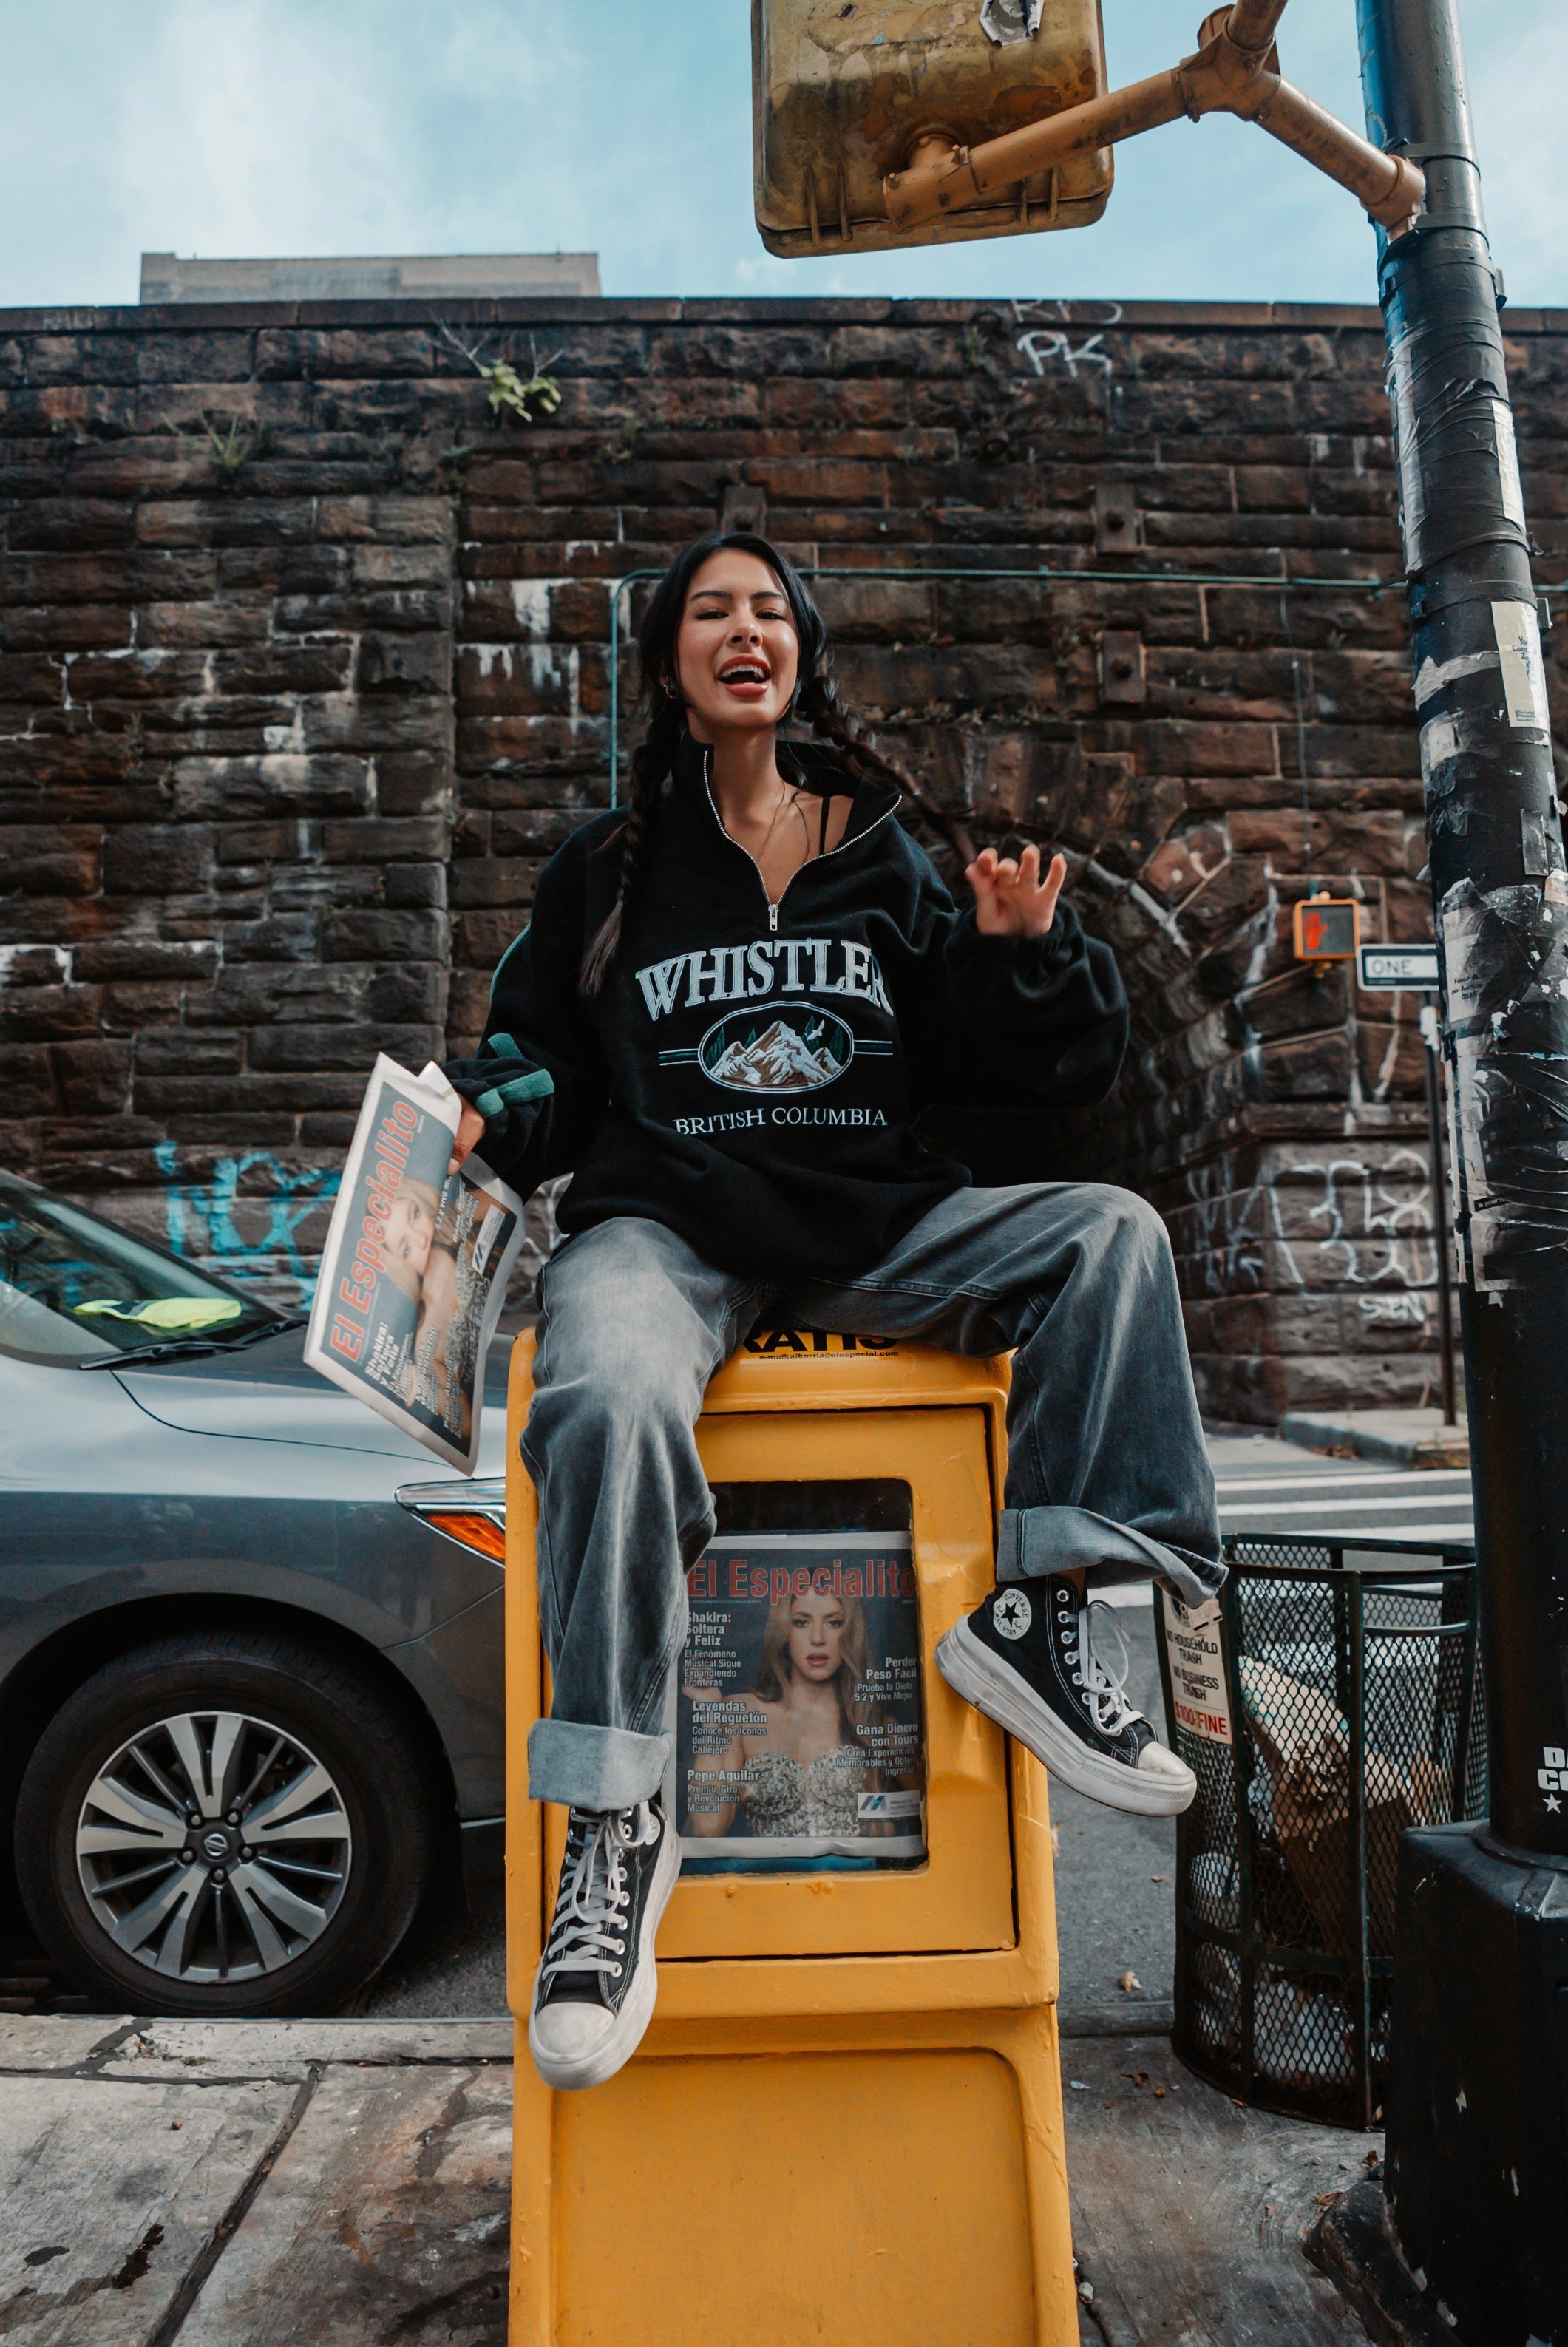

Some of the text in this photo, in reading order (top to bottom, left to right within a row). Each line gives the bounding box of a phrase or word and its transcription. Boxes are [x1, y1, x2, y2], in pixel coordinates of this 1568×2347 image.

[1371, 959, 1413, 975] ONE
[635, 938, 893, 1022] WHISTLER
[673, 1107, 889, 1135] BRITISH COLUMBIA
[330, 1101, 419, 1363] El Especialito
[688, 1559, 916, 1606] El Especialito
[1005, 1593, 1028, 1618] CONVERSE
[1002, 1626, 1017, 1635] STAR
[685, 1634, 721, 1648] y Feliz
[1167, 1629, 1218, 1654] NO HOUSEHOLD
[685, 1648, 736, 1658] El Fenómeno
[1178, 1648, 1203, 1665] TRASH
[684, 1659, 741, 1670] Musical Sigue
[886, 1657, 917, 1668] Perder
[684, 1668, 737, 1679] Expandiendo
[866, 1668, 892, 1680] Peso
[1172, 1665, 1219, 1690] NO BUSINESS
[684, 1677, 724, 1686] Fronteras
[857, 1682, 913, 1692] Prueba la Dieta
[855, 1691, 913, 1702] 5:2 y Vive Mejor
[1183, 1682, 1206, 1701] TRASH
[692, 1700, 746, 1712] Leyendas
[692, 1711, 767, 1725] del Reguetón
[1175, 1700, 1228, 1735] $100 FINE
[692, 1726, 722, 1735] Conoce
[725, 1726, 737, 1735] los
[856, 1722, 918, 1736] Gana Dinero
[692, 1736, 731, 1745] del Ritmo
[871, 1735, 919, 1747] con Tours
[692, 1745, 728, 1755] Callejero
[846, 1747, 914, 1759] Crea Experiencias
[836, 1758, 886, 1767] Memorables
[889, 1759, 893, 1767] y
[1543, 1746, 1568, 1768] D
[687, 1770, 760, 1783] Pepe Aguilar
[885, 1767, 915, 1776] Ingresos
[687, 1784, 738, 1794] Premio, Gira
[687, 1796, 693, 1804] y
[687, 1803, 720, 1812] Musical
